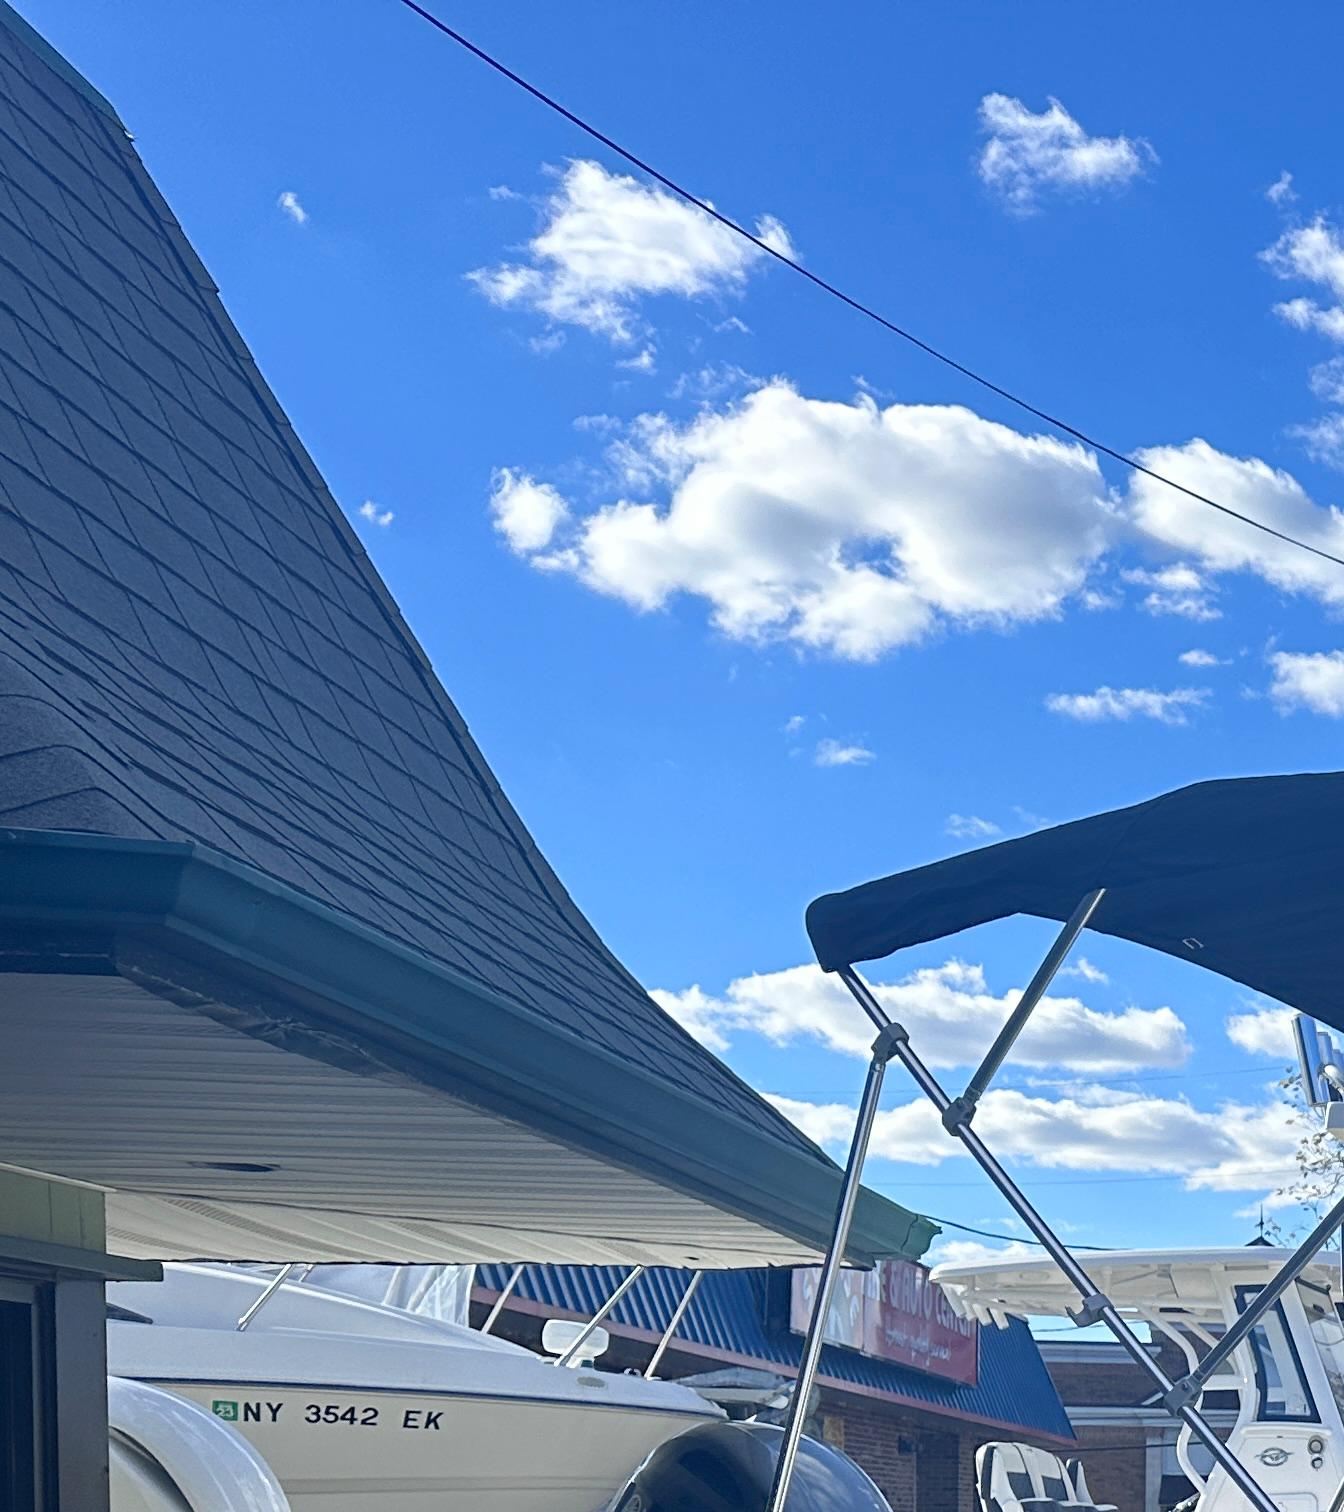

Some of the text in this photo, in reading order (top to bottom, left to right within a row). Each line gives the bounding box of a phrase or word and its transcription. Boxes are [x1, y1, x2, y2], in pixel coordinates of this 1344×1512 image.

[243, 1402, 444, 1430] NY 3542 EK
